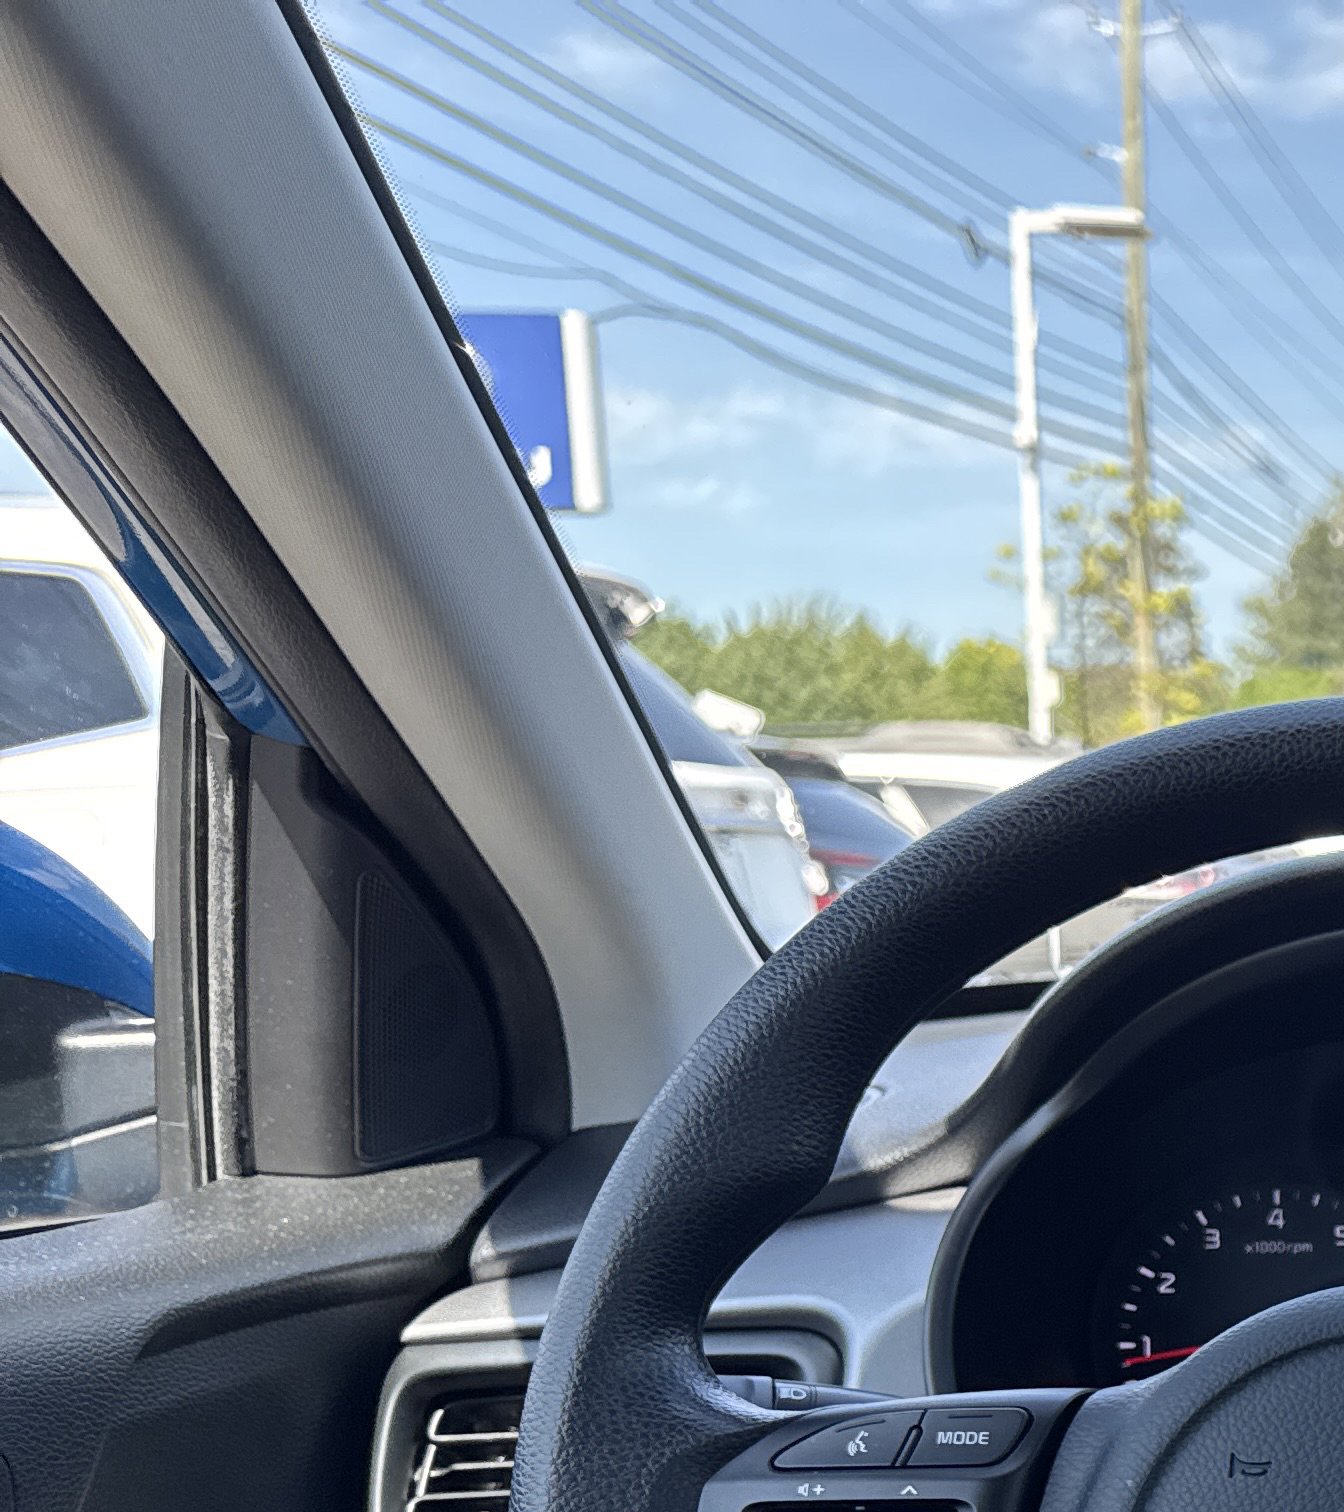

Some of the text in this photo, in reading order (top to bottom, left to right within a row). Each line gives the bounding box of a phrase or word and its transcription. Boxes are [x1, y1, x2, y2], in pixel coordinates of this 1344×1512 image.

[1267, 1208, 1285, 1230] 4
[1203, 1228, 1221, 1249] 3
[1157, 1272, 1176, 1294] 2
[1141, 1335, 1151, 1357] 1
[936, 1431, 990, 1445] MODE
